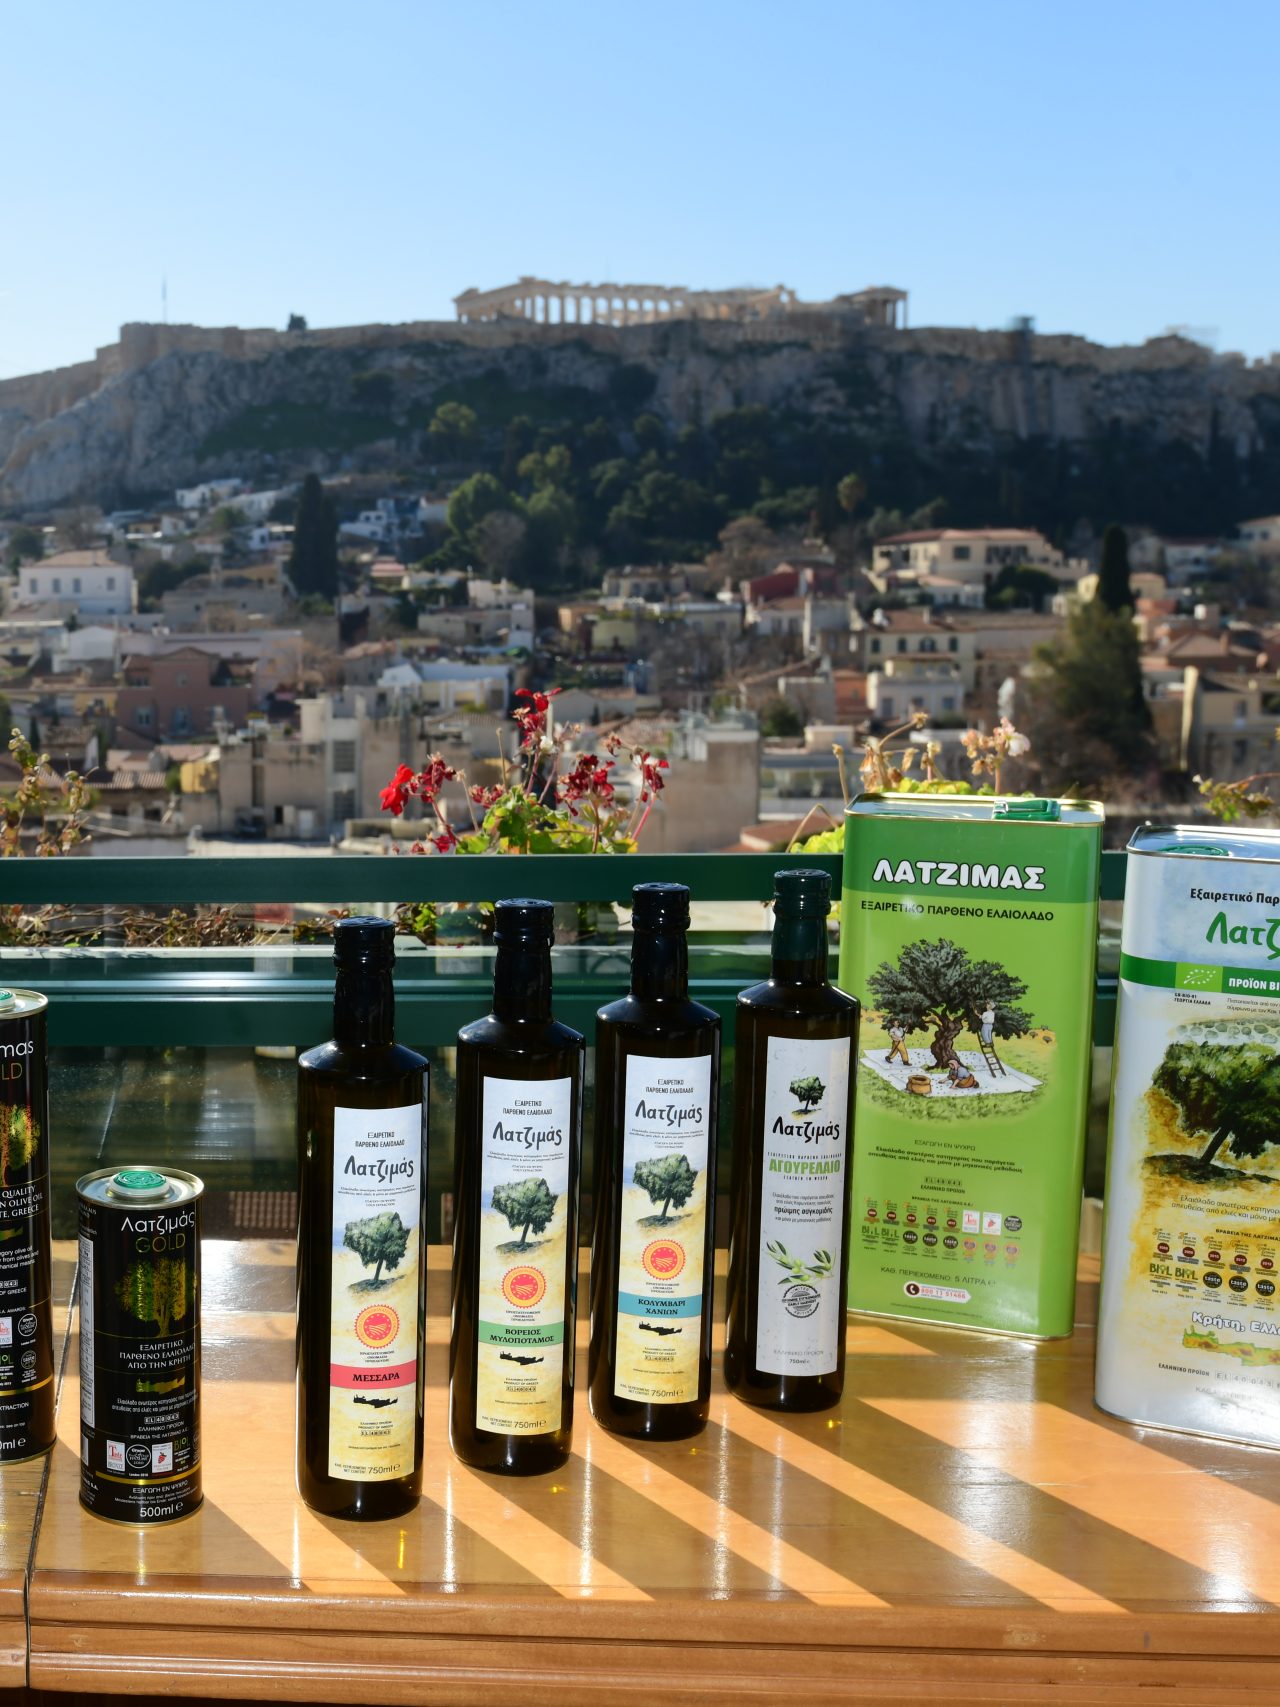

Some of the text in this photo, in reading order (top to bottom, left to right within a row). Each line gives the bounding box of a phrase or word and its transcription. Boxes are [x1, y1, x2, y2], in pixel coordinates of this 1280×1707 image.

[873, 858, 1046, 891] ΛΑΤΖΙΜΑΣ
[1190, 888, 1280, 907] Εξαιρετικό Παρ
[861, 900, 1054, 921] ΕΞΑΙΡΕΤΙΚΟ ΠΑΡΘΕΝΟ ΕΛΑΙΟΛΑΔΟ
[1206, 911, 1280, 961] Λατζ
[1229, 977, 1267, 990] ΠΡΟΪΟΝ
[635, 1099, 703, 1128] Λατζιμάς
[492, 1121, 562, 1150] Λατζιμάς
[772, 1116, 840, 1144] Λατζιμάς
[344, 1155, 414, 1183] Λατζιμάς
[769, 1159, 840, 1175] ΑΓΟΥΡΕΛΑΙΟ
[2, 1185, 36, 1198] QUALITY
[8, 1197, 32, 1208] OLIVE
[11, 1205, 39, 1217] GREECE
[121, 1211, 195, 1235] Λατζιμάς
[136, 1233, 185, 1252] GOLD
[638, 1299, 686, 1307] ΚΟΛΥΜΒΑΡΙ
[140, 1339, 183, 1351] ΕΞΑΙΡΕΤΙΚΟ
[490, 1335, 554, 1343] ΜΥΛΟΠΟΤΑΜΟΣ
[120, 1351, 160, 1360] ΠΑΡΘΕΝΟ
[169, 1354, 191, 1366] ΚΡΗΤΗ
[352, 1372, 400, 1381] ΜΕΣΣΑΡΑ
[651, 1389, 676, 1397] 750ml
[514, 1420, 539, 1429] 750ml
[368, 1465, 392, 1474] 750ml
[140, 1504, 174, 1518] 500ml
